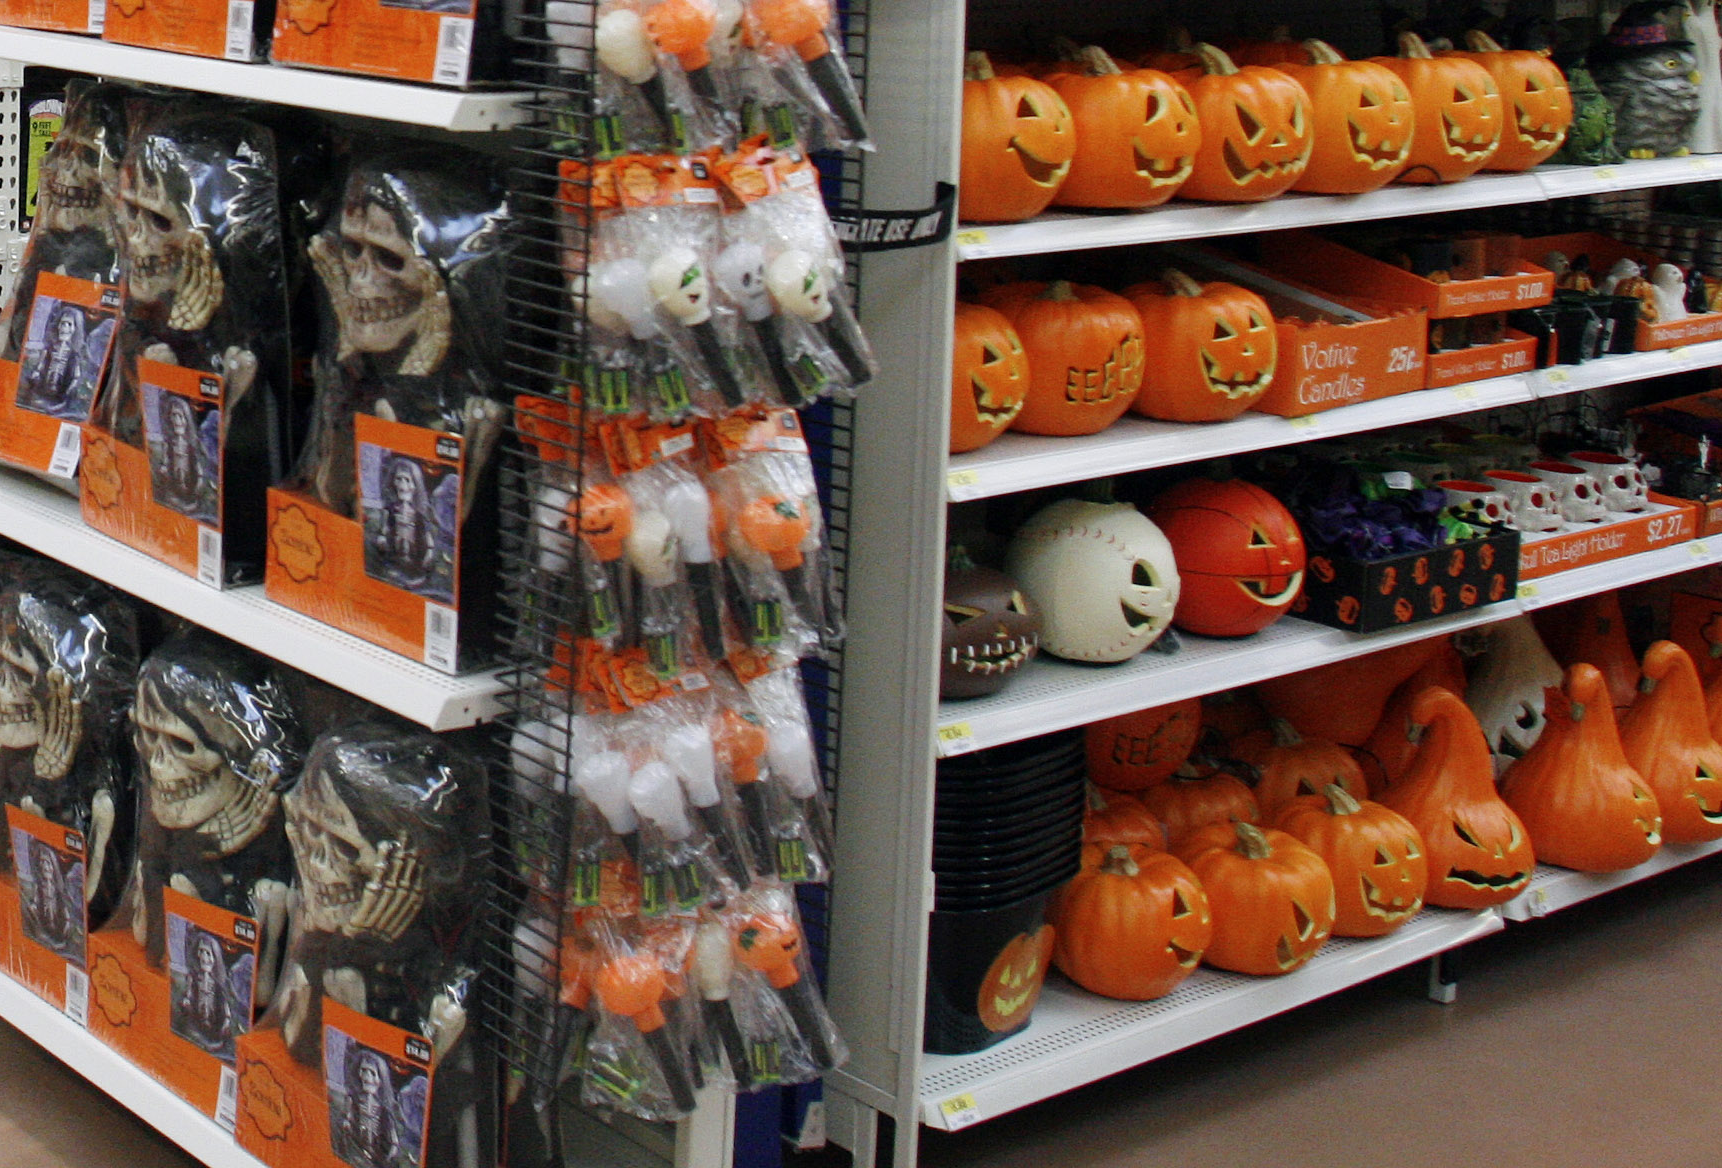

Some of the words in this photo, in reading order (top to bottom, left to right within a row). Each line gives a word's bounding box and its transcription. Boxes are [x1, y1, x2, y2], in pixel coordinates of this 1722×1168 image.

[1301, 341, 1359, 371] Votive
[1298, 372, 1366, 405] Candles
[1647, 514, 1684, 544] $2.27
[1541, 545, 1562, 565] Tea
[1562, 539, 1590, 564] Light
[1590, 531, 1627, 555] Holder
